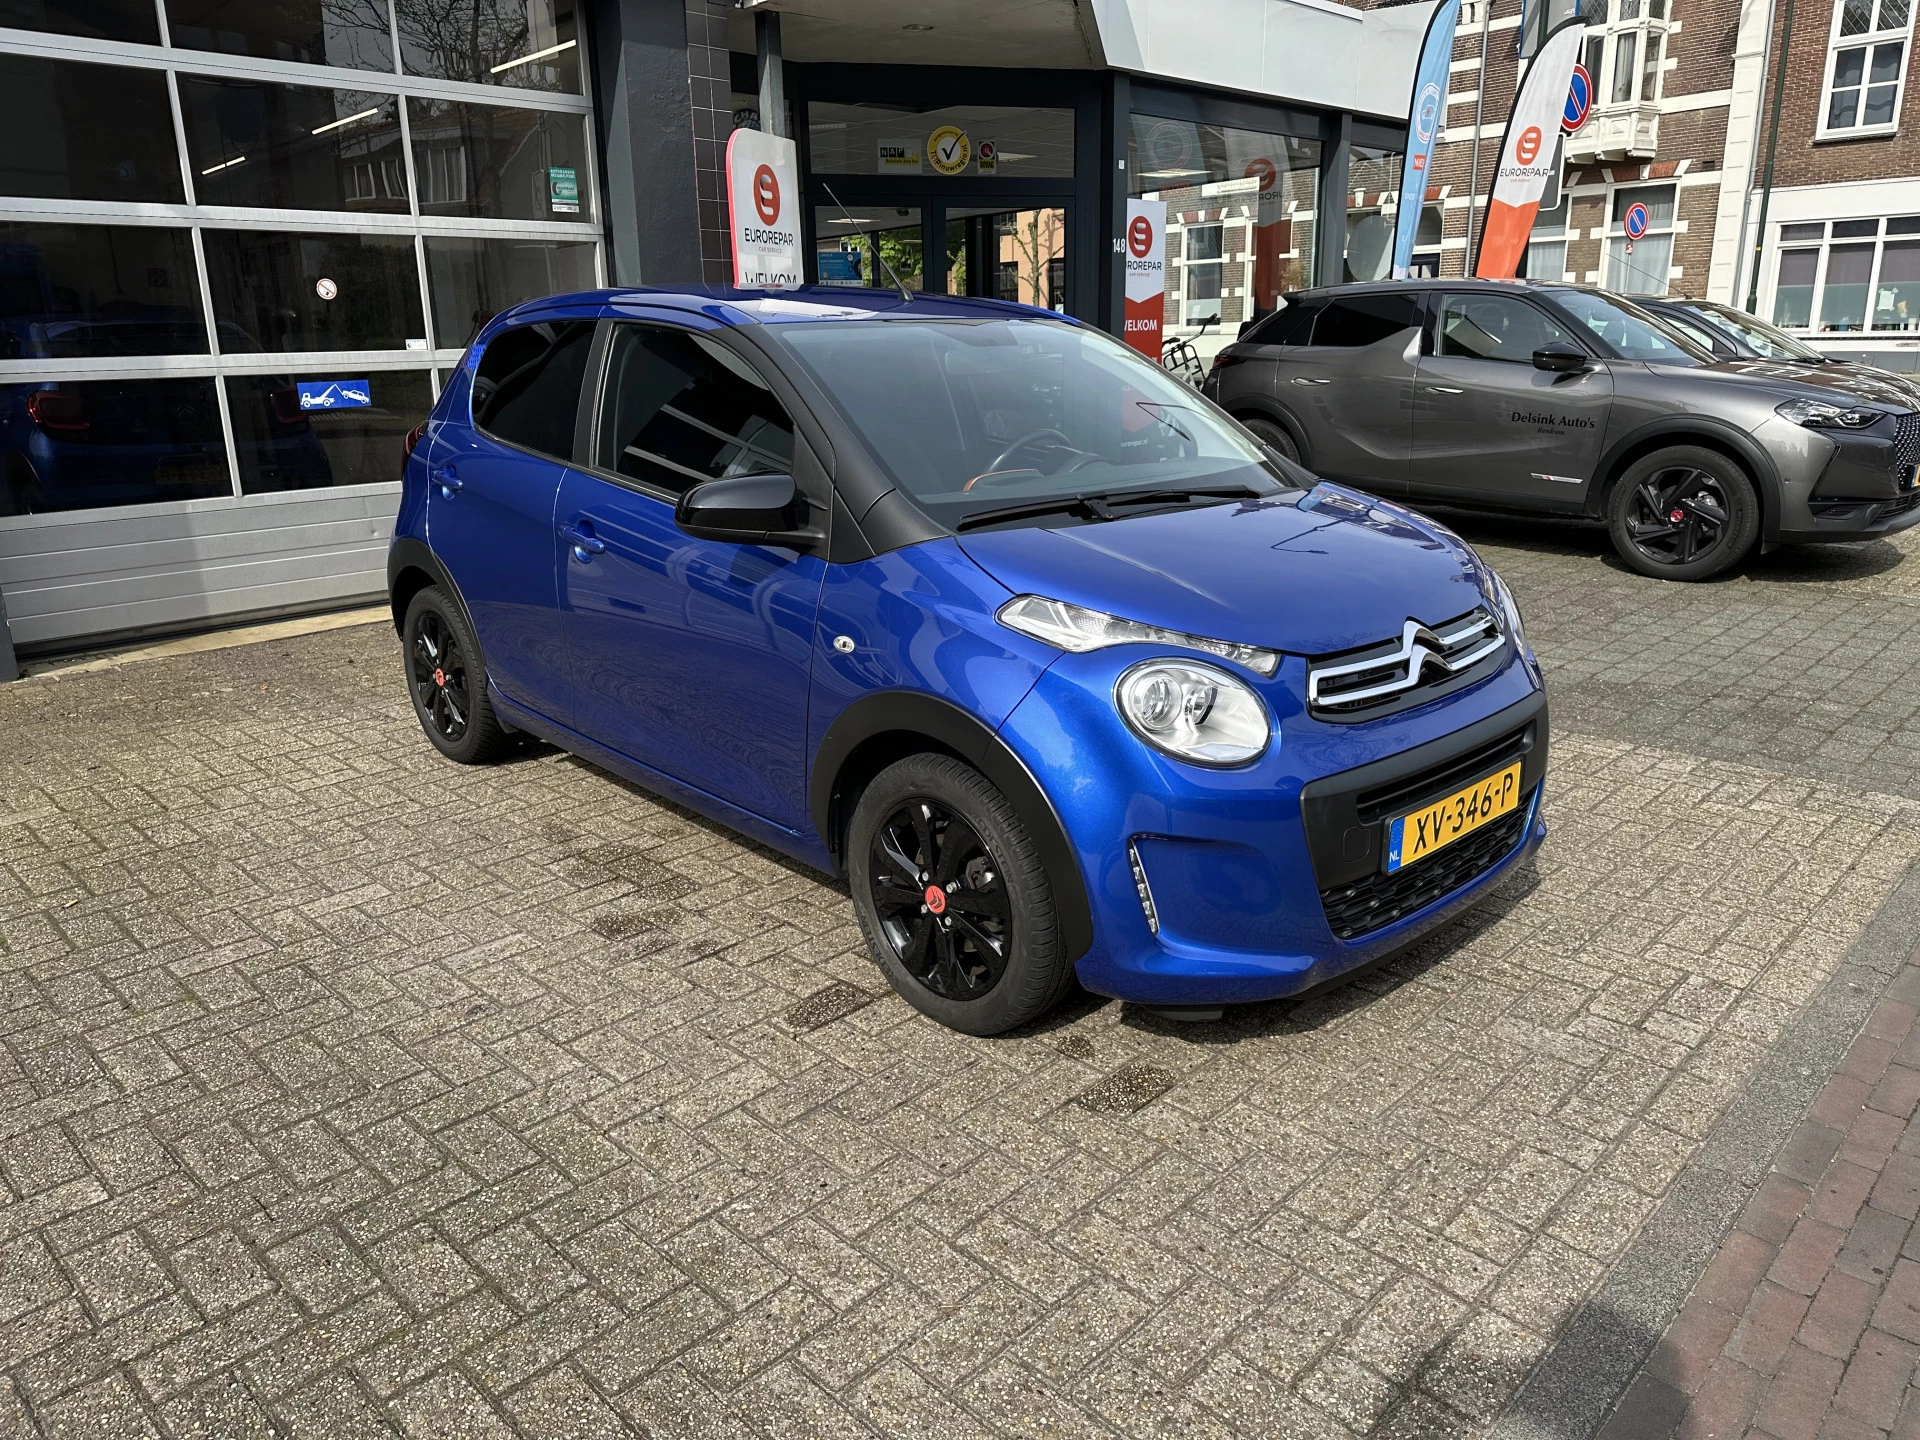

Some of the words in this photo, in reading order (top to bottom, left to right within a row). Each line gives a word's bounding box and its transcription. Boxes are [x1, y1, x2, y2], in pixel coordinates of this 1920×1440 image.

[881, 147, 904, 157] NAP
[1500, 168, 1549, 178] EUROREPAR
[744, 228, 794, 246] EUROREPAR
[1113, 238, 1126, 253] 148
[1126, 261, 1162, 271] ROREPAR
[1511, 411, 1555, 425] Delsink
[1559, 415, 1595, 429] Auto's
[1537, 426, 1565, 435] Renkum
[1413, 772, 1514, 854] XV-346-P
[1389, 849, 1400, 863] NL
